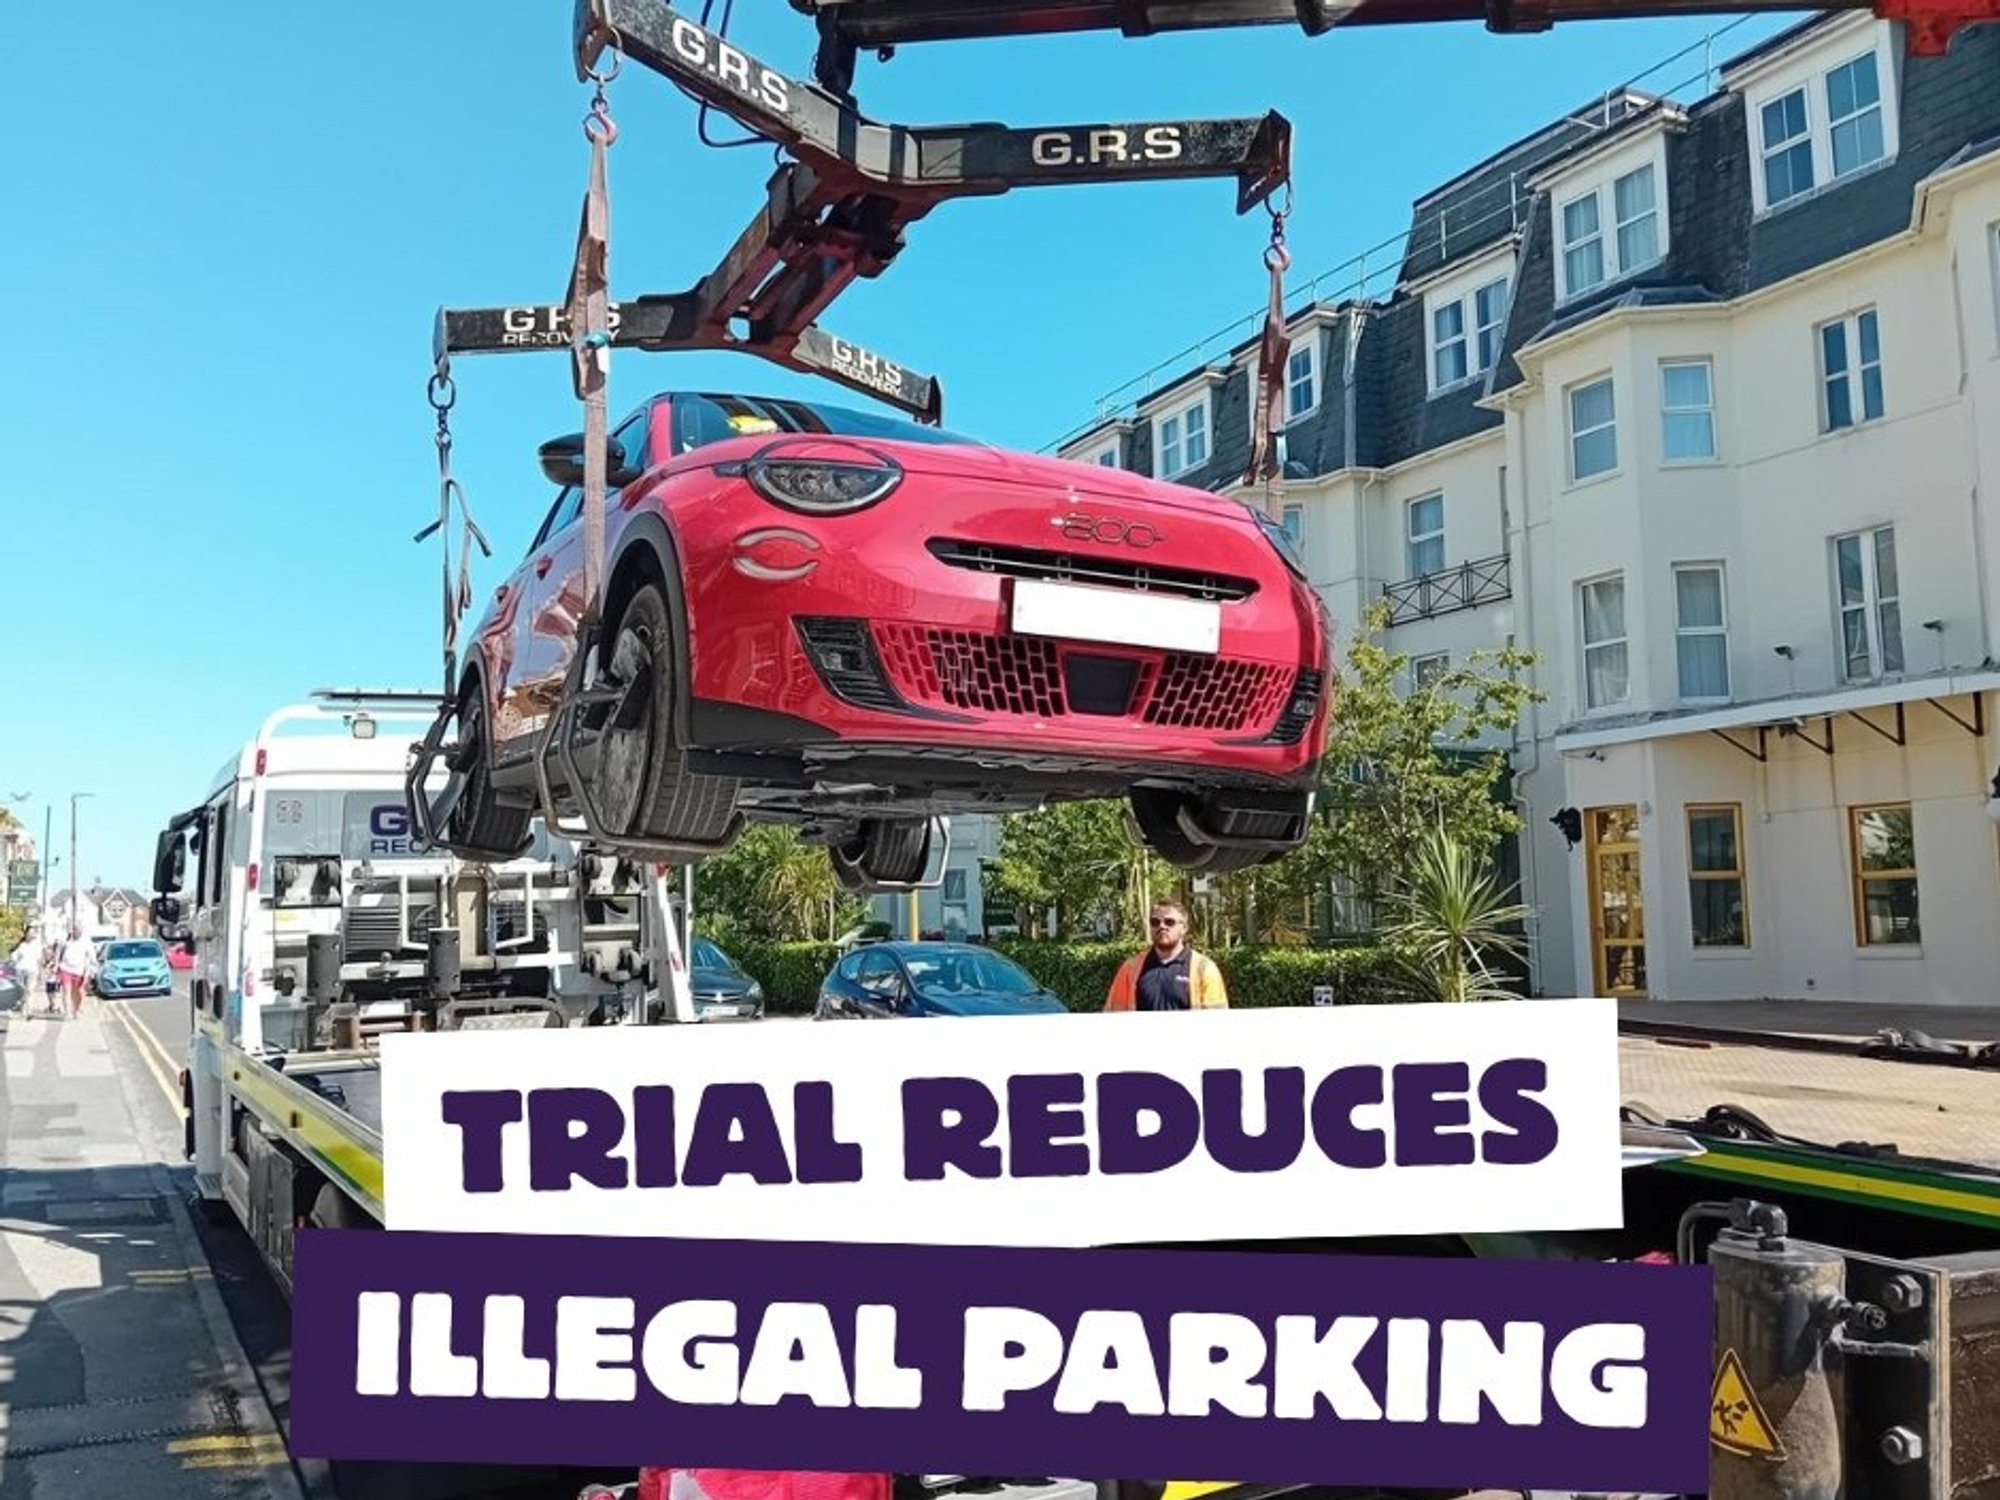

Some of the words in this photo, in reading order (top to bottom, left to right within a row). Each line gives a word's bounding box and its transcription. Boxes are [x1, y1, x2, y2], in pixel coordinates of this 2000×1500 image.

[672, 18, 788, 112] G.R.S
[1031, 126, 1183, 166] G.R.S
[503, 329, 621, 347] RECOVY
